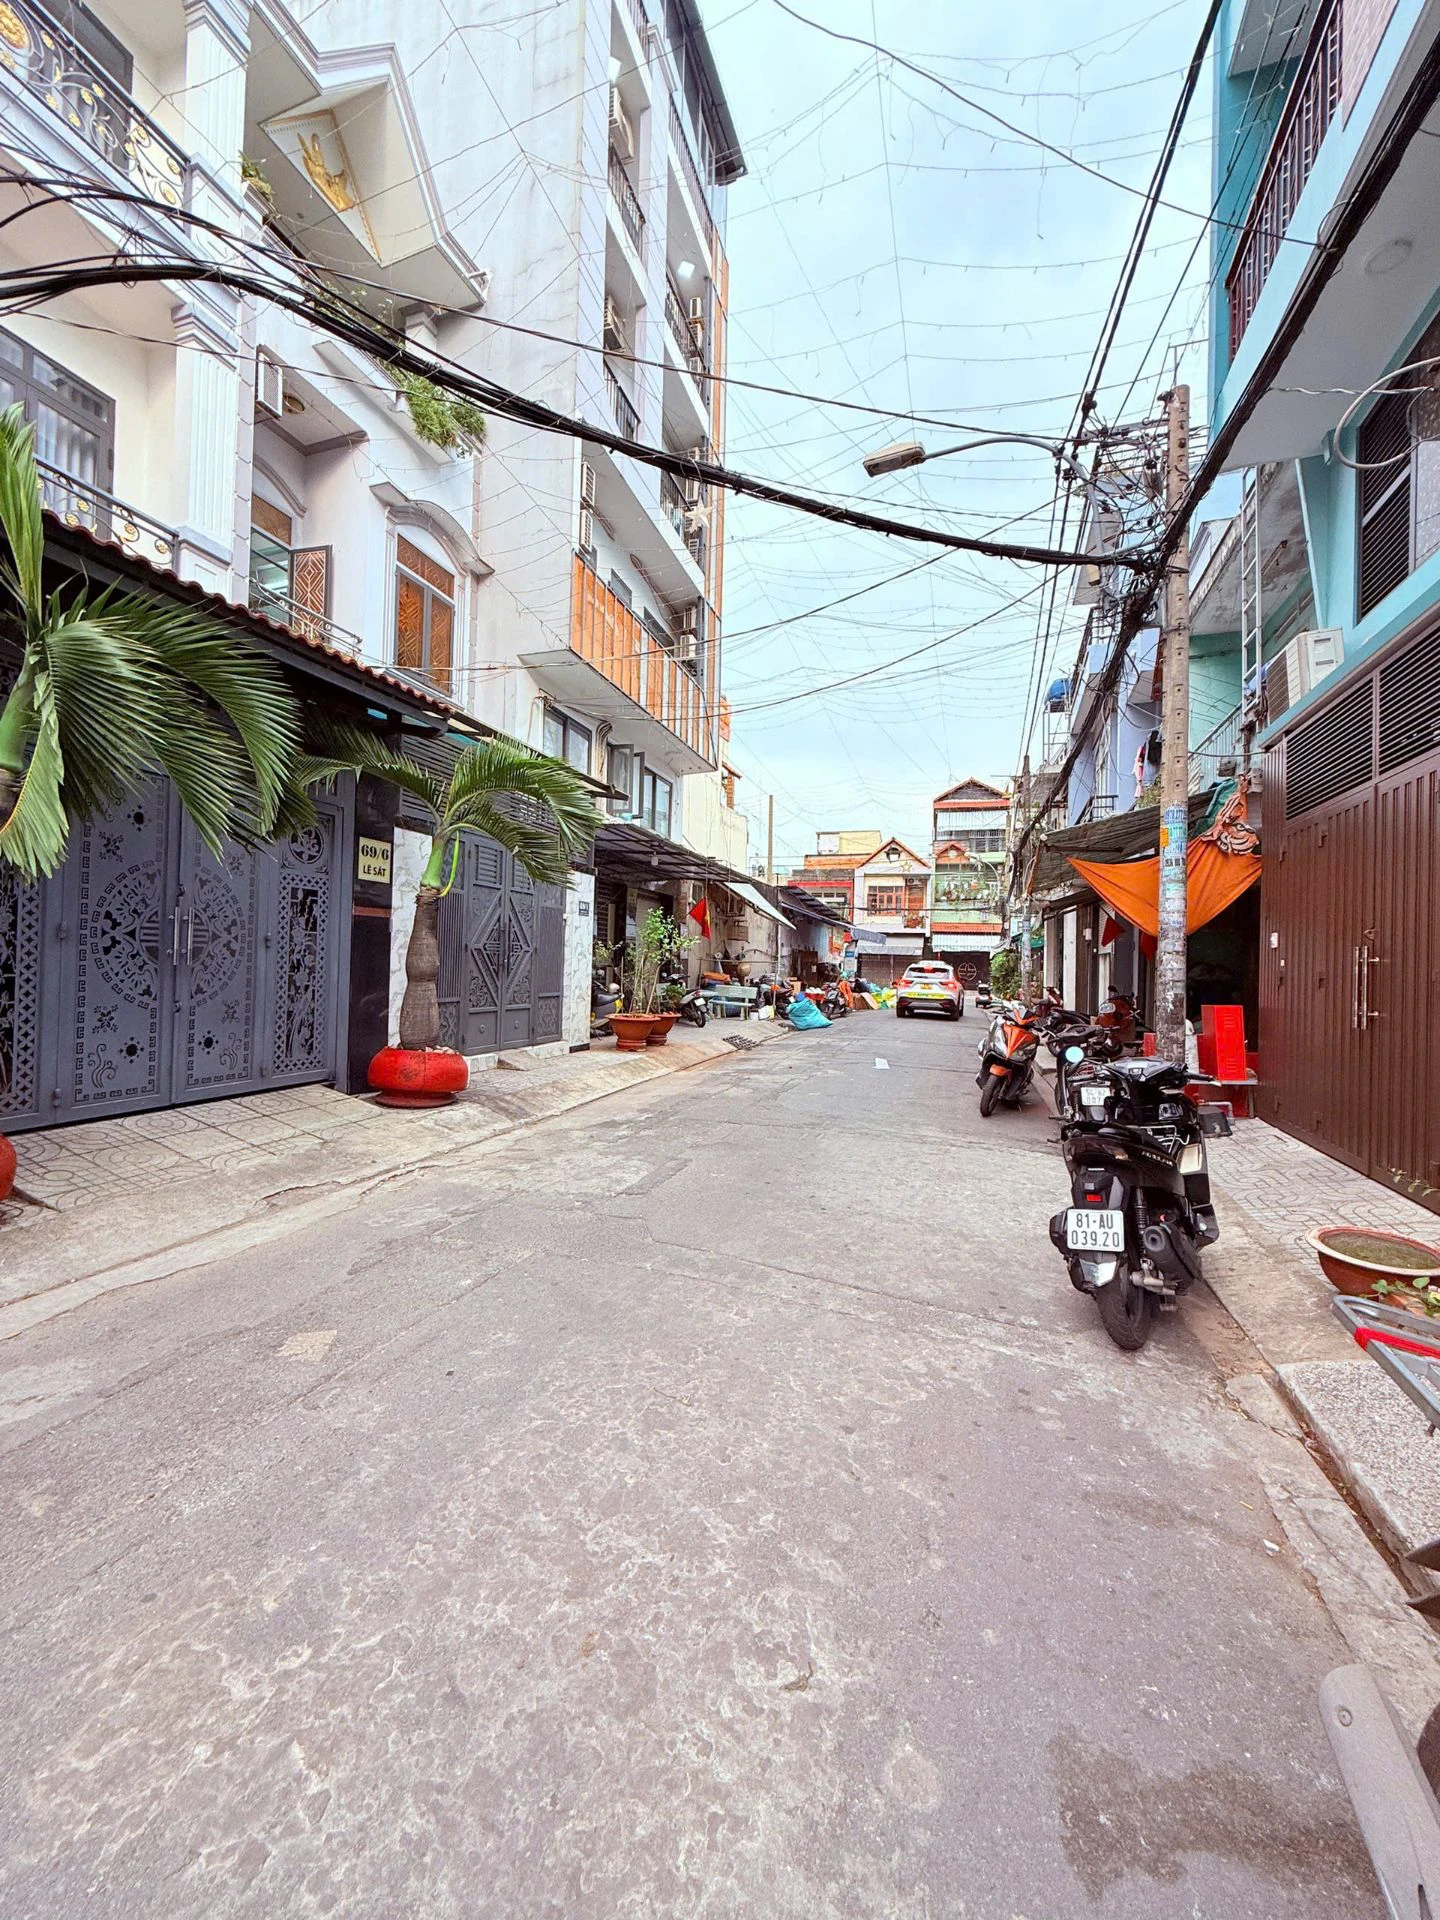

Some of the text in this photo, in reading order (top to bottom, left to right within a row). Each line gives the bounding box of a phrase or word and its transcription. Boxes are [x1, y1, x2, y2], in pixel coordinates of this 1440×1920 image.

[361, 844, 389, 861] 69/6
[363, 864, 371, 875] LÊ
[1076, 1213, 1114, 1230] 81-AU
[1071, 1230, 1120, 1248] 039.20
